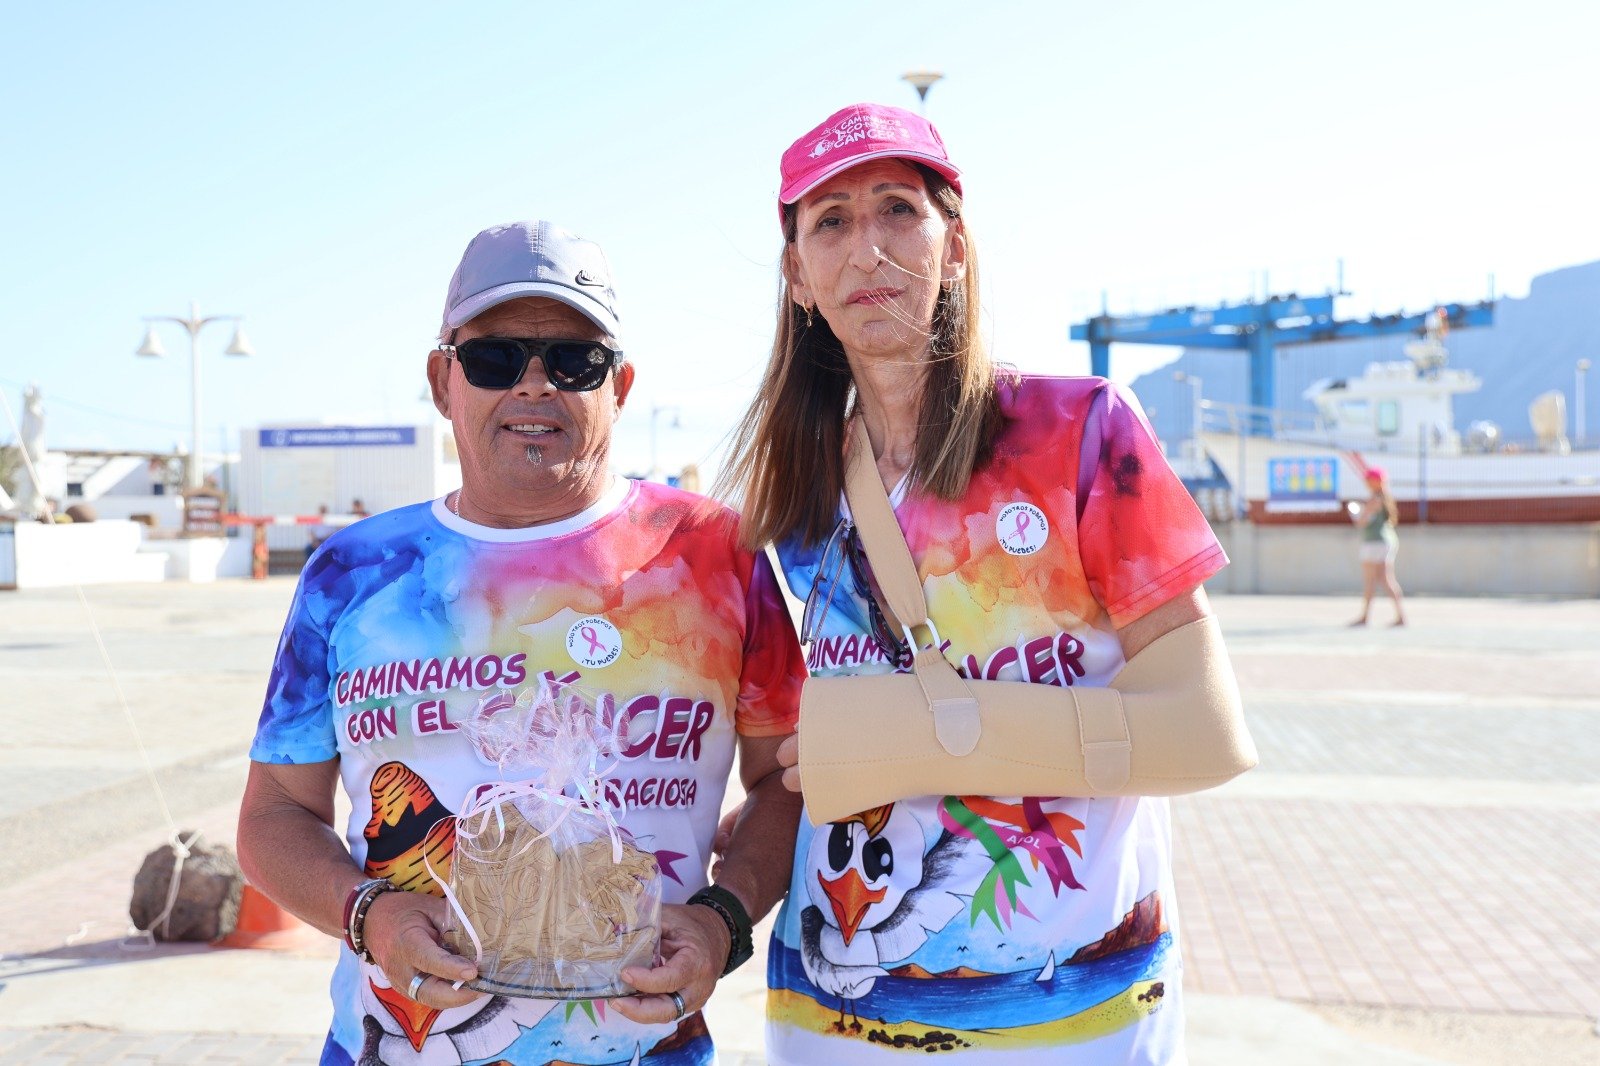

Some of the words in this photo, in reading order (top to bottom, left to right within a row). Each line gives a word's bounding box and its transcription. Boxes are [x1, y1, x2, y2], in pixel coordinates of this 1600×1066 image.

[1000, 505, 1028, 522] NOSOTROS
[1029, 507, 1046, 531] PODEMOS
[568, 620, 585, 648] NOSOTROS
[586, 618, 613, 630] PODEMOS
[335, 652, 527, 707] CAMINAMOS
[346, 705, 398, 746] CON
[412, 699, 459, 737] EL
[579, 777, 698, 811] RACIOSA
